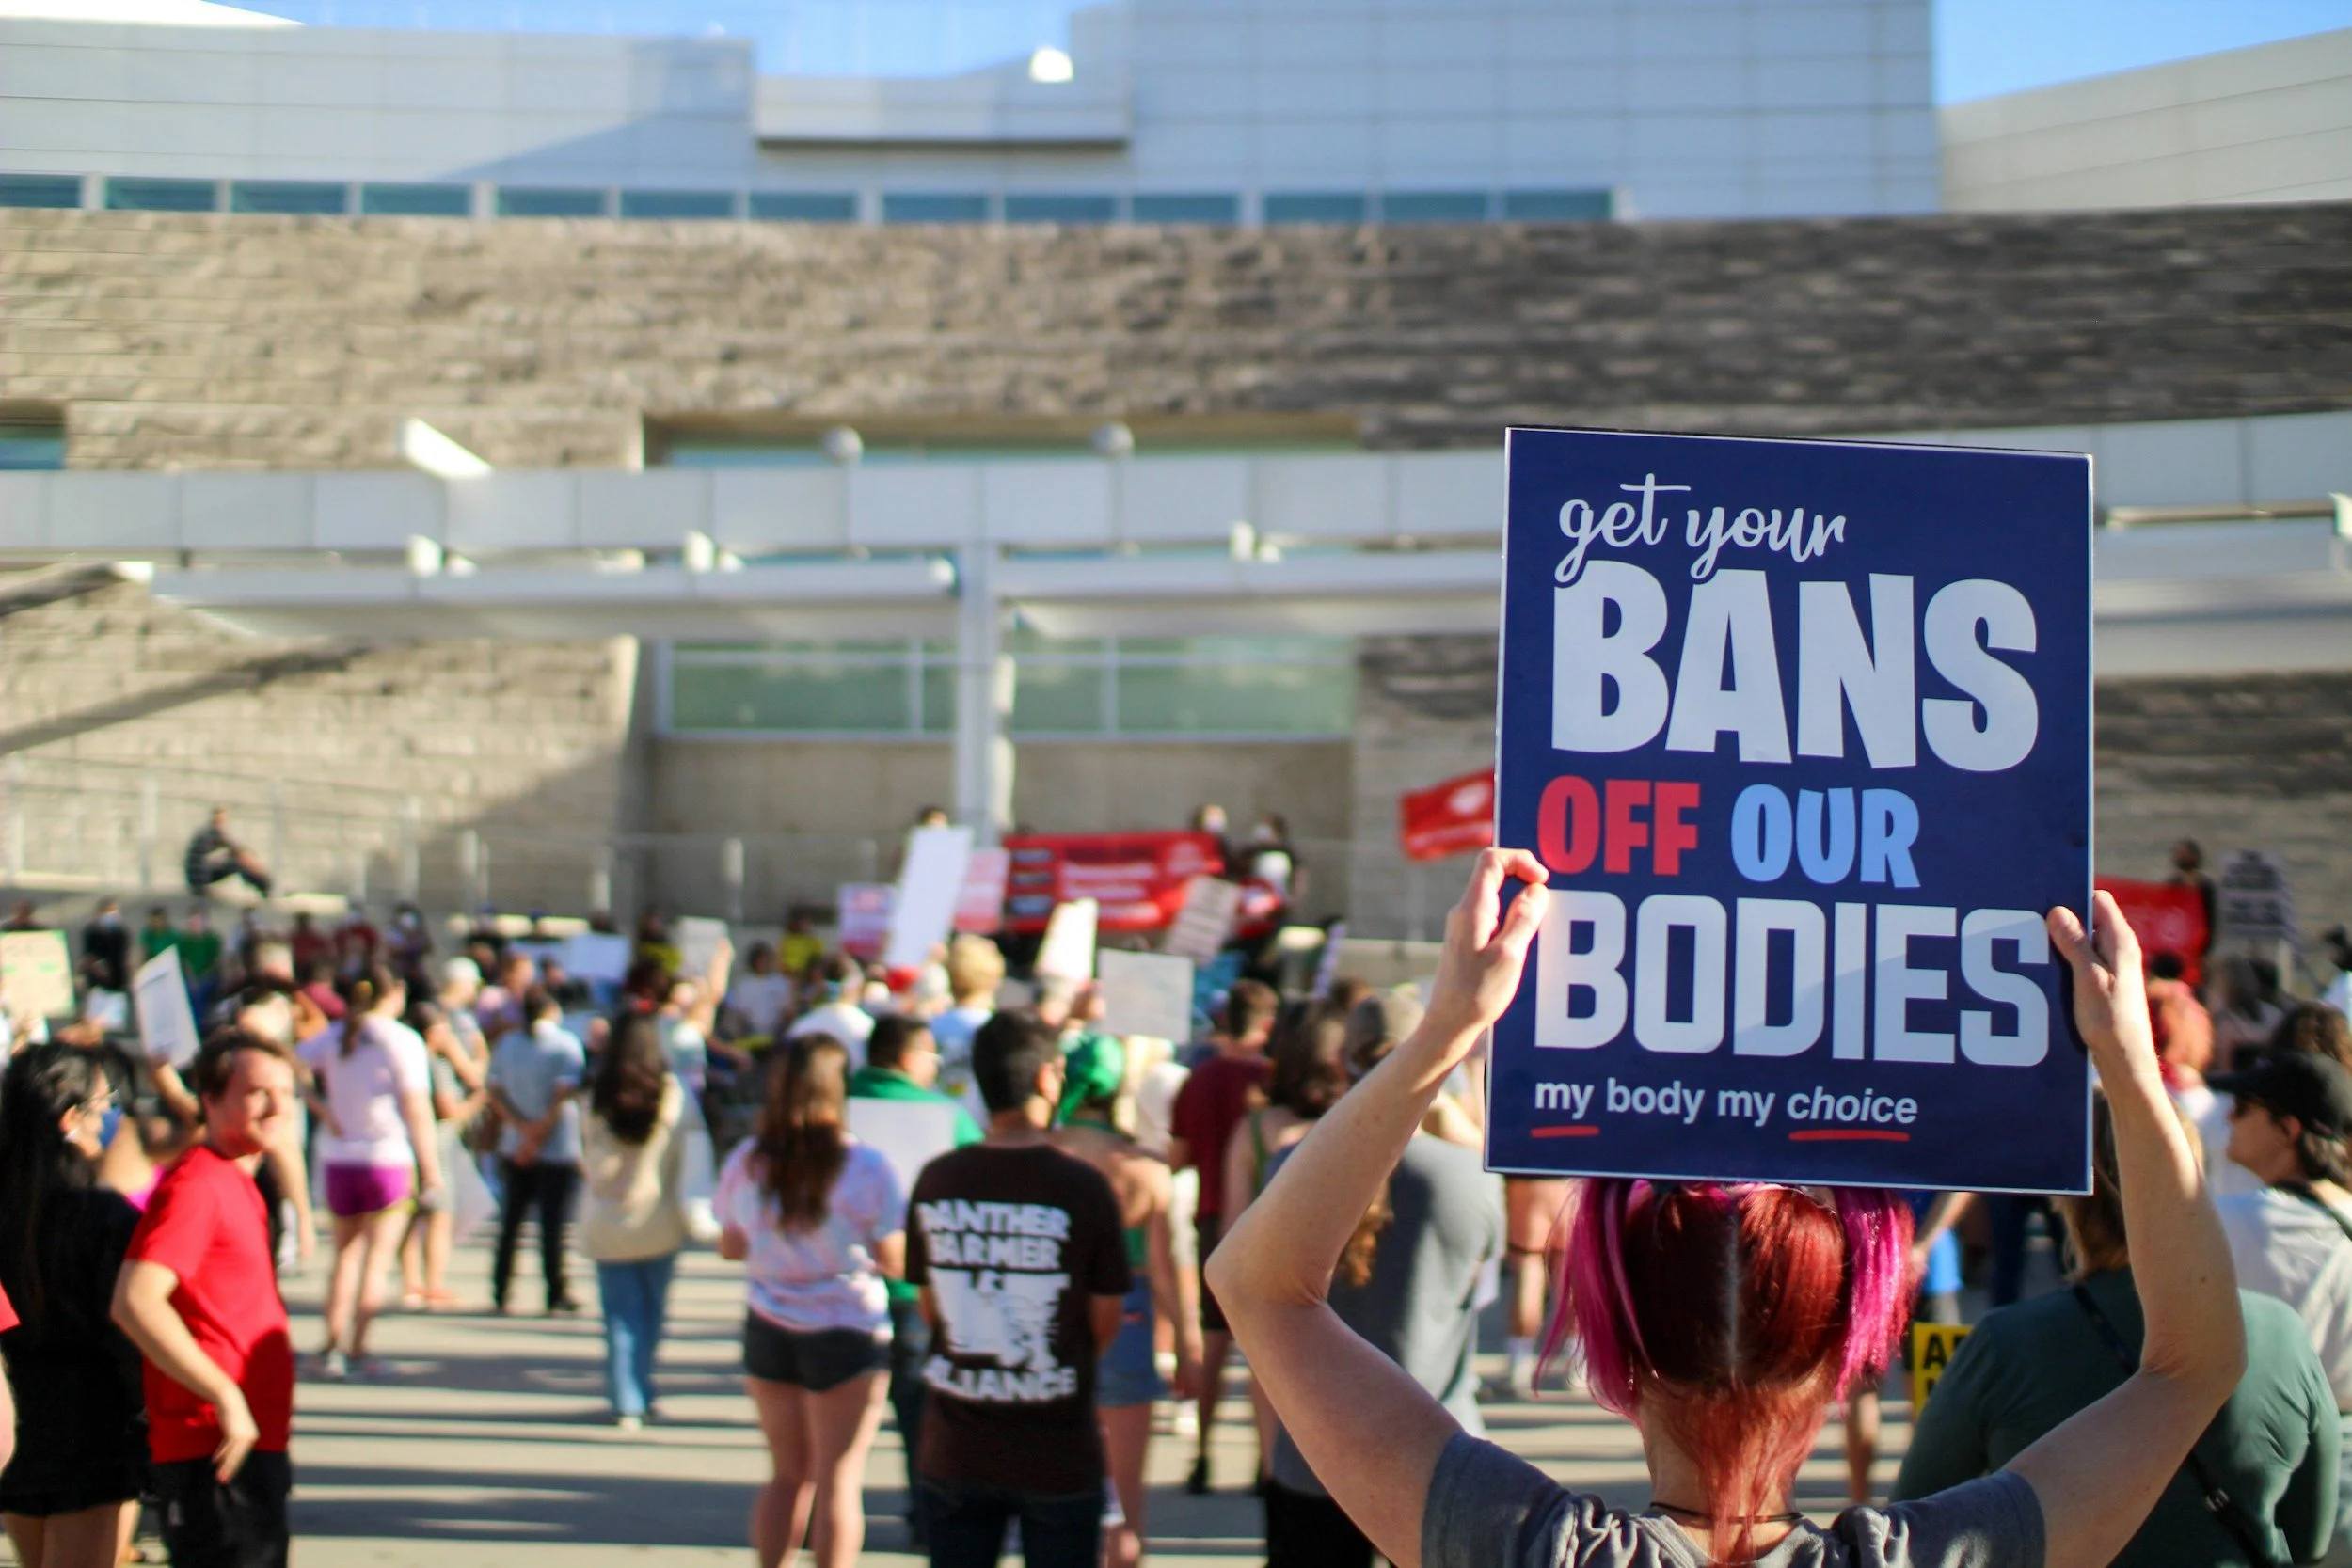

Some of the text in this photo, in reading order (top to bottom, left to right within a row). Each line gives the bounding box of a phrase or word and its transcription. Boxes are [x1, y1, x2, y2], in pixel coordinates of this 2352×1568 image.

[1555, 472, 1847, 584] get your
[1551, 560, 2040, 773] BANS
[1537, 774, 1921, 889] OFF OUR
[1534, 889, 2051, 1068] BODIES
[1534, 1077, 1919, 1127] my body my choice
